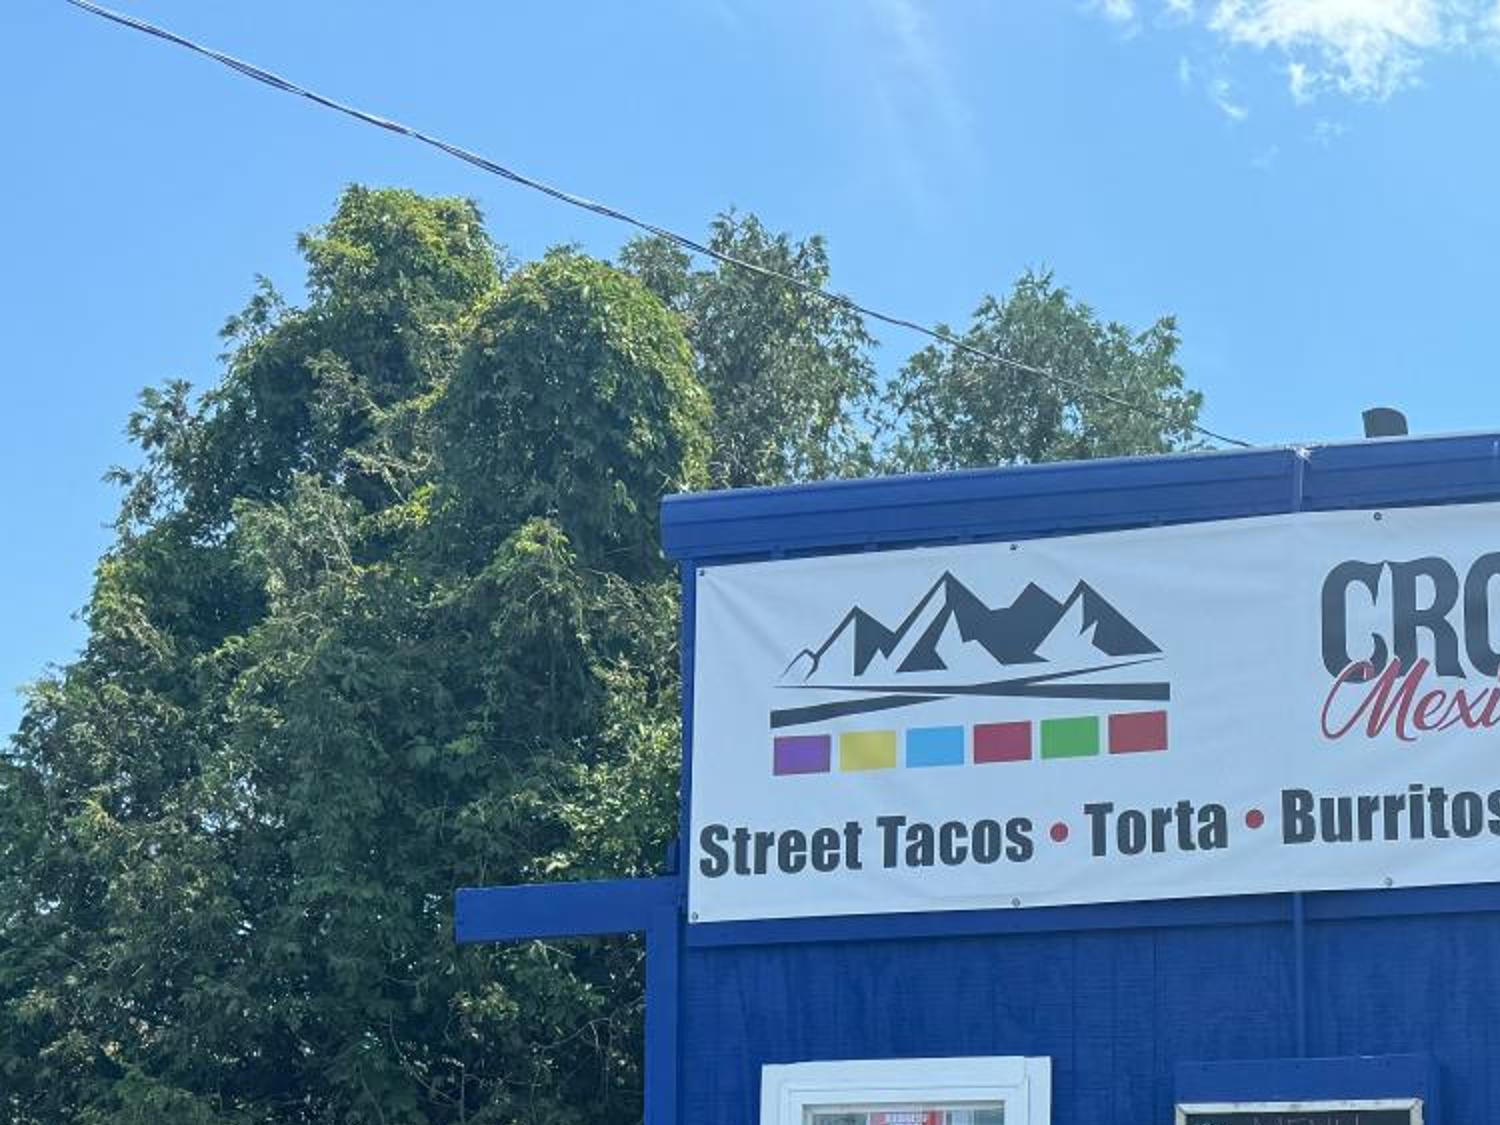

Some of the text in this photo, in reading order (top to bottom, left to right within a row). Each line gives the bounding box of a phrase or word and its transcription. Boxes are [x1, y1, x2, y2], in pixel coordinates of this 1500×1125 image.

[699, 820, 863, 878] Street
[876, 815, 1034, 869] Tacos
[1084, 800, 1228, 857] Torta
